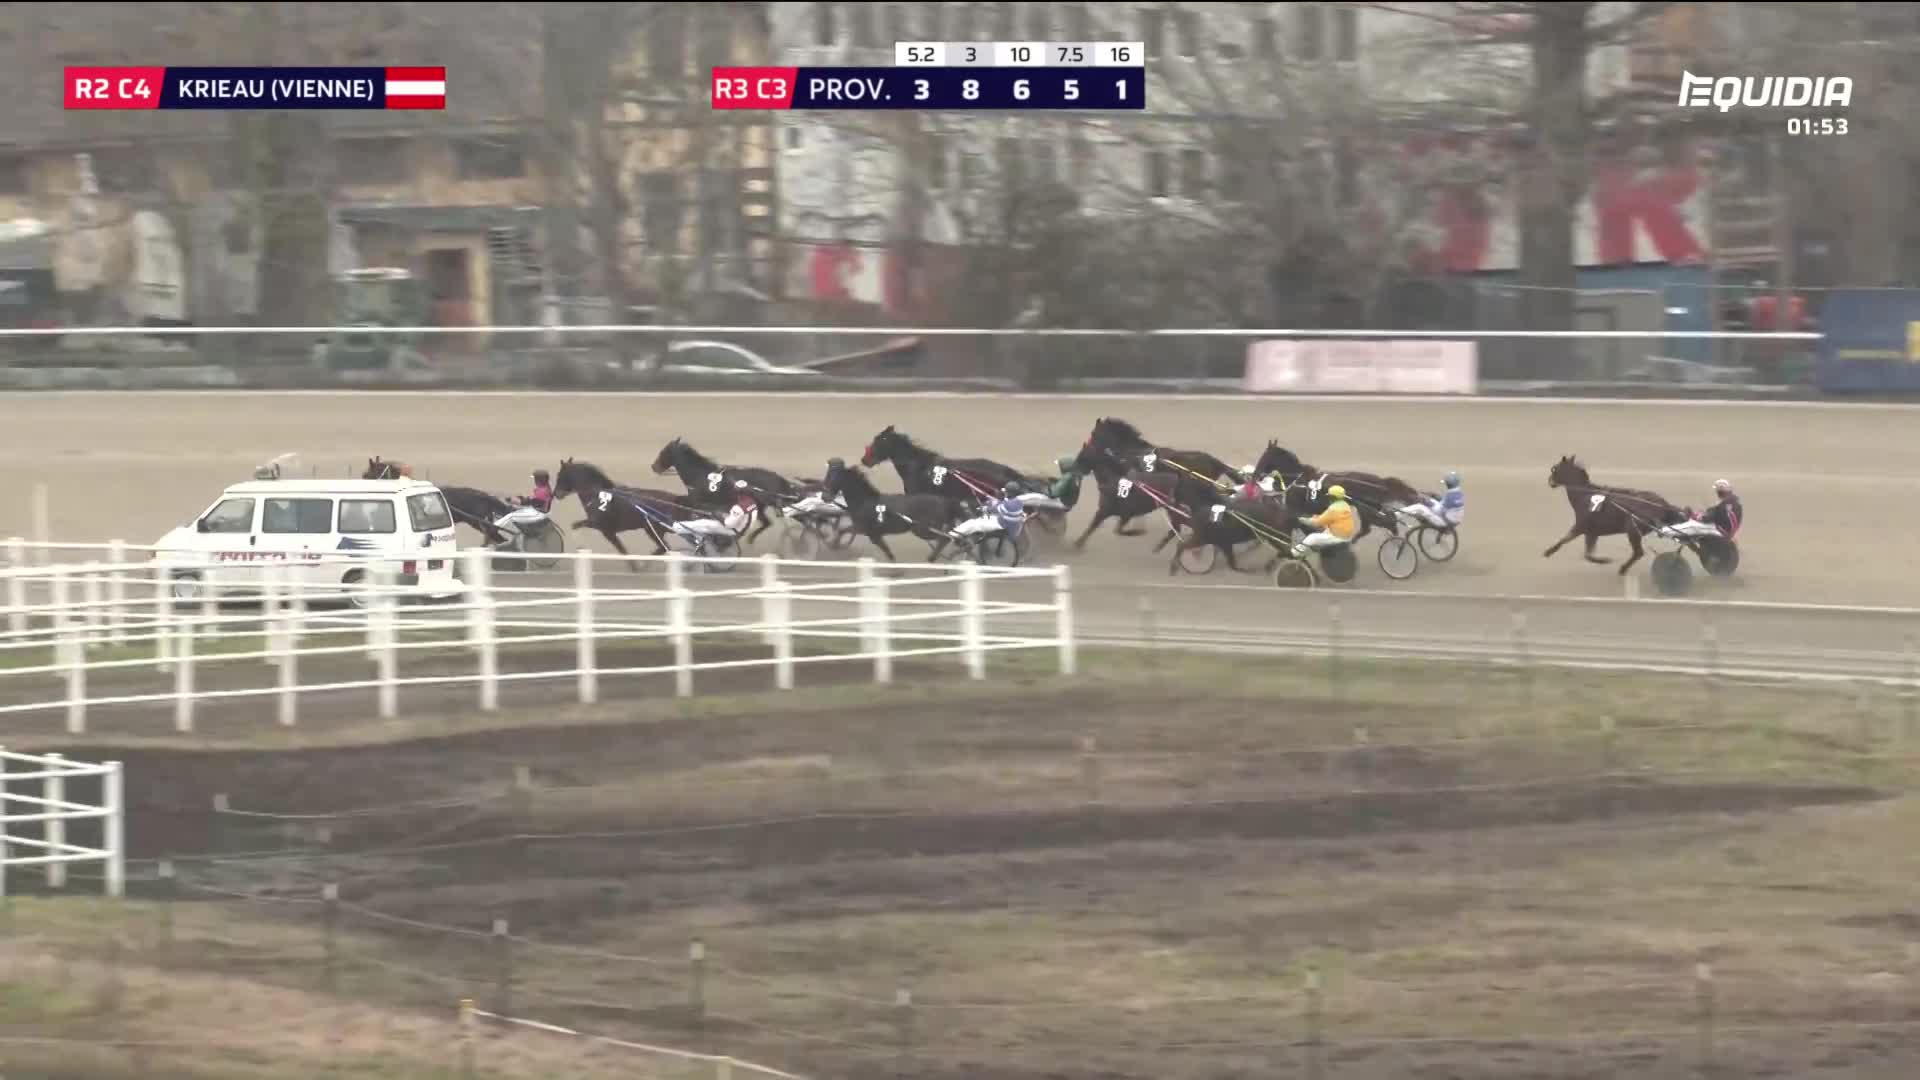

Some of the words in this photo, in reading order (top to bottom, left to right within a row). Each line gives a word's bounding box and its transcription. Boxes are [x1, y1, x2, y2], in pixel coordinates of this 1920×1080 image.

[708, 480, 717, 493] 6
[1117, 487, 1129, 498] 10
[598, 499, 607, 512] 2
